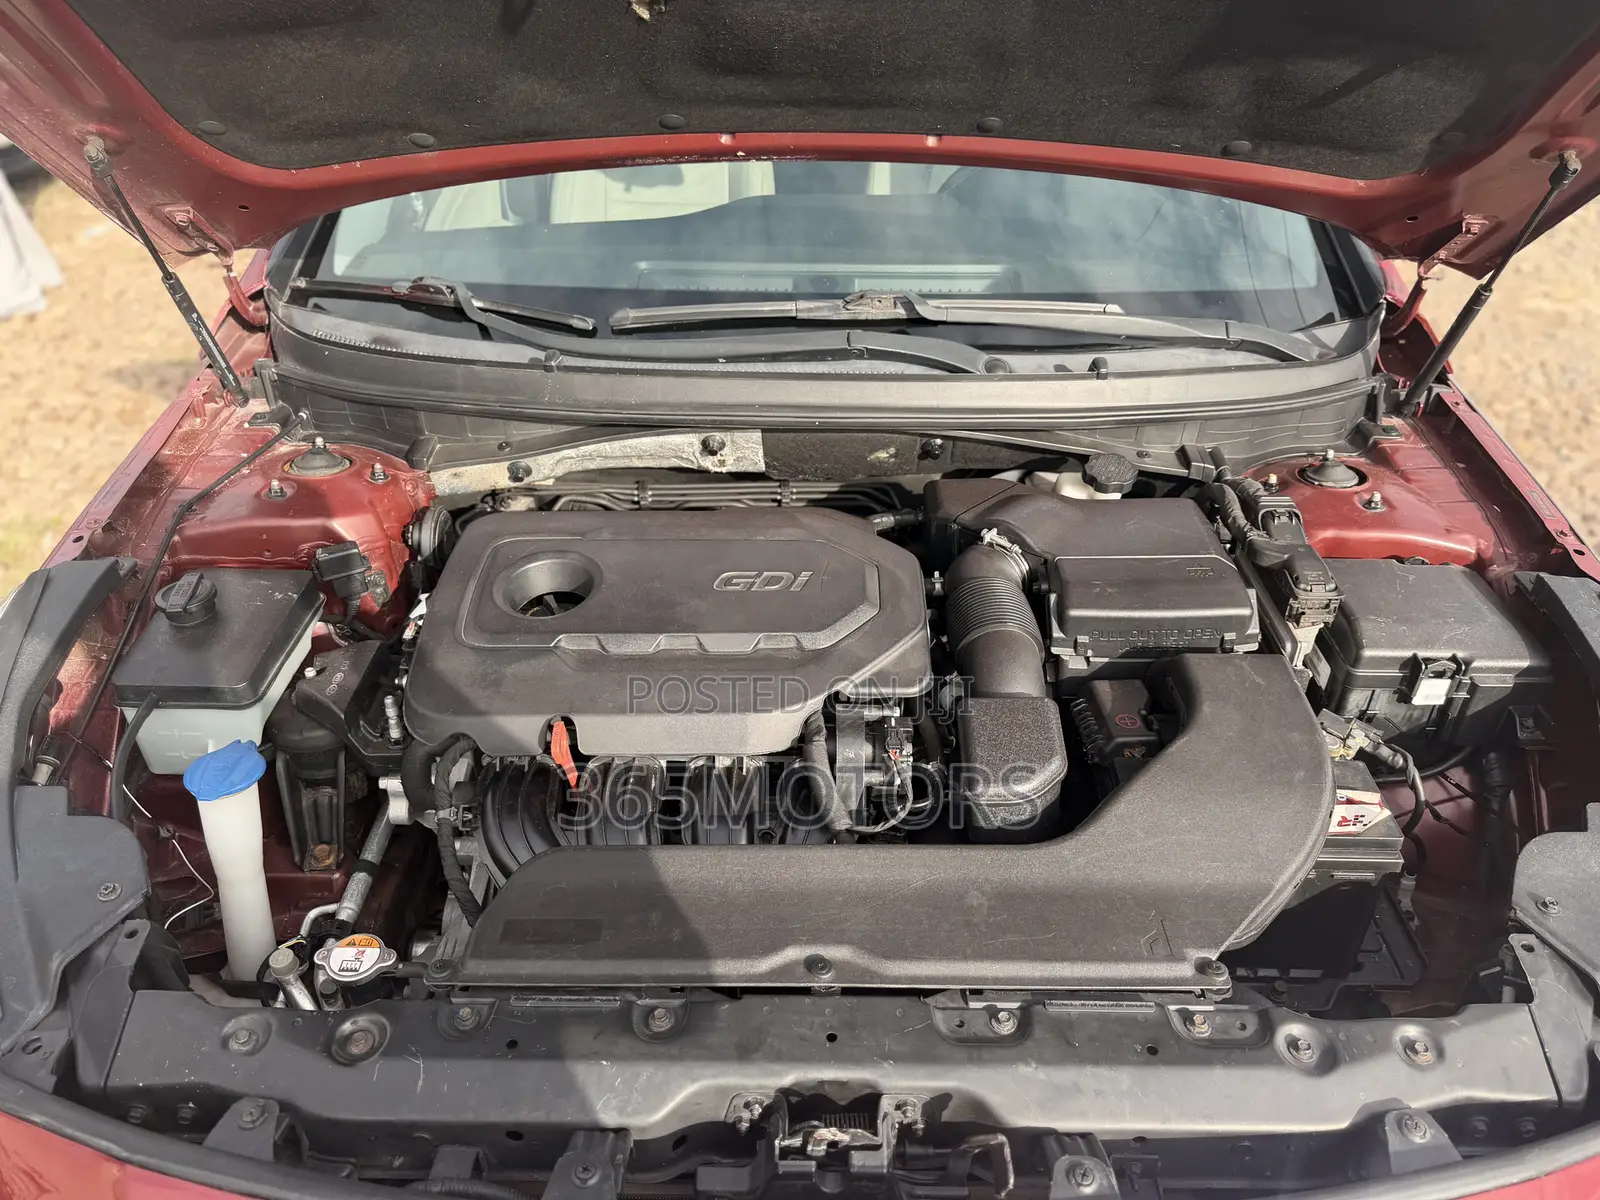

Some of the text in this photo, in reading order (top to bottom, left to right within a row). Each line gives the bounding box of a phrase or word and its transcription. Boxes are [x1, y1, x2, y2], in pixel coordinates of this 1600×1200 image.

[713, 571, 814, 592] GDi
[1090, 627, 1223, 641] PULL OUT TO OPEN
